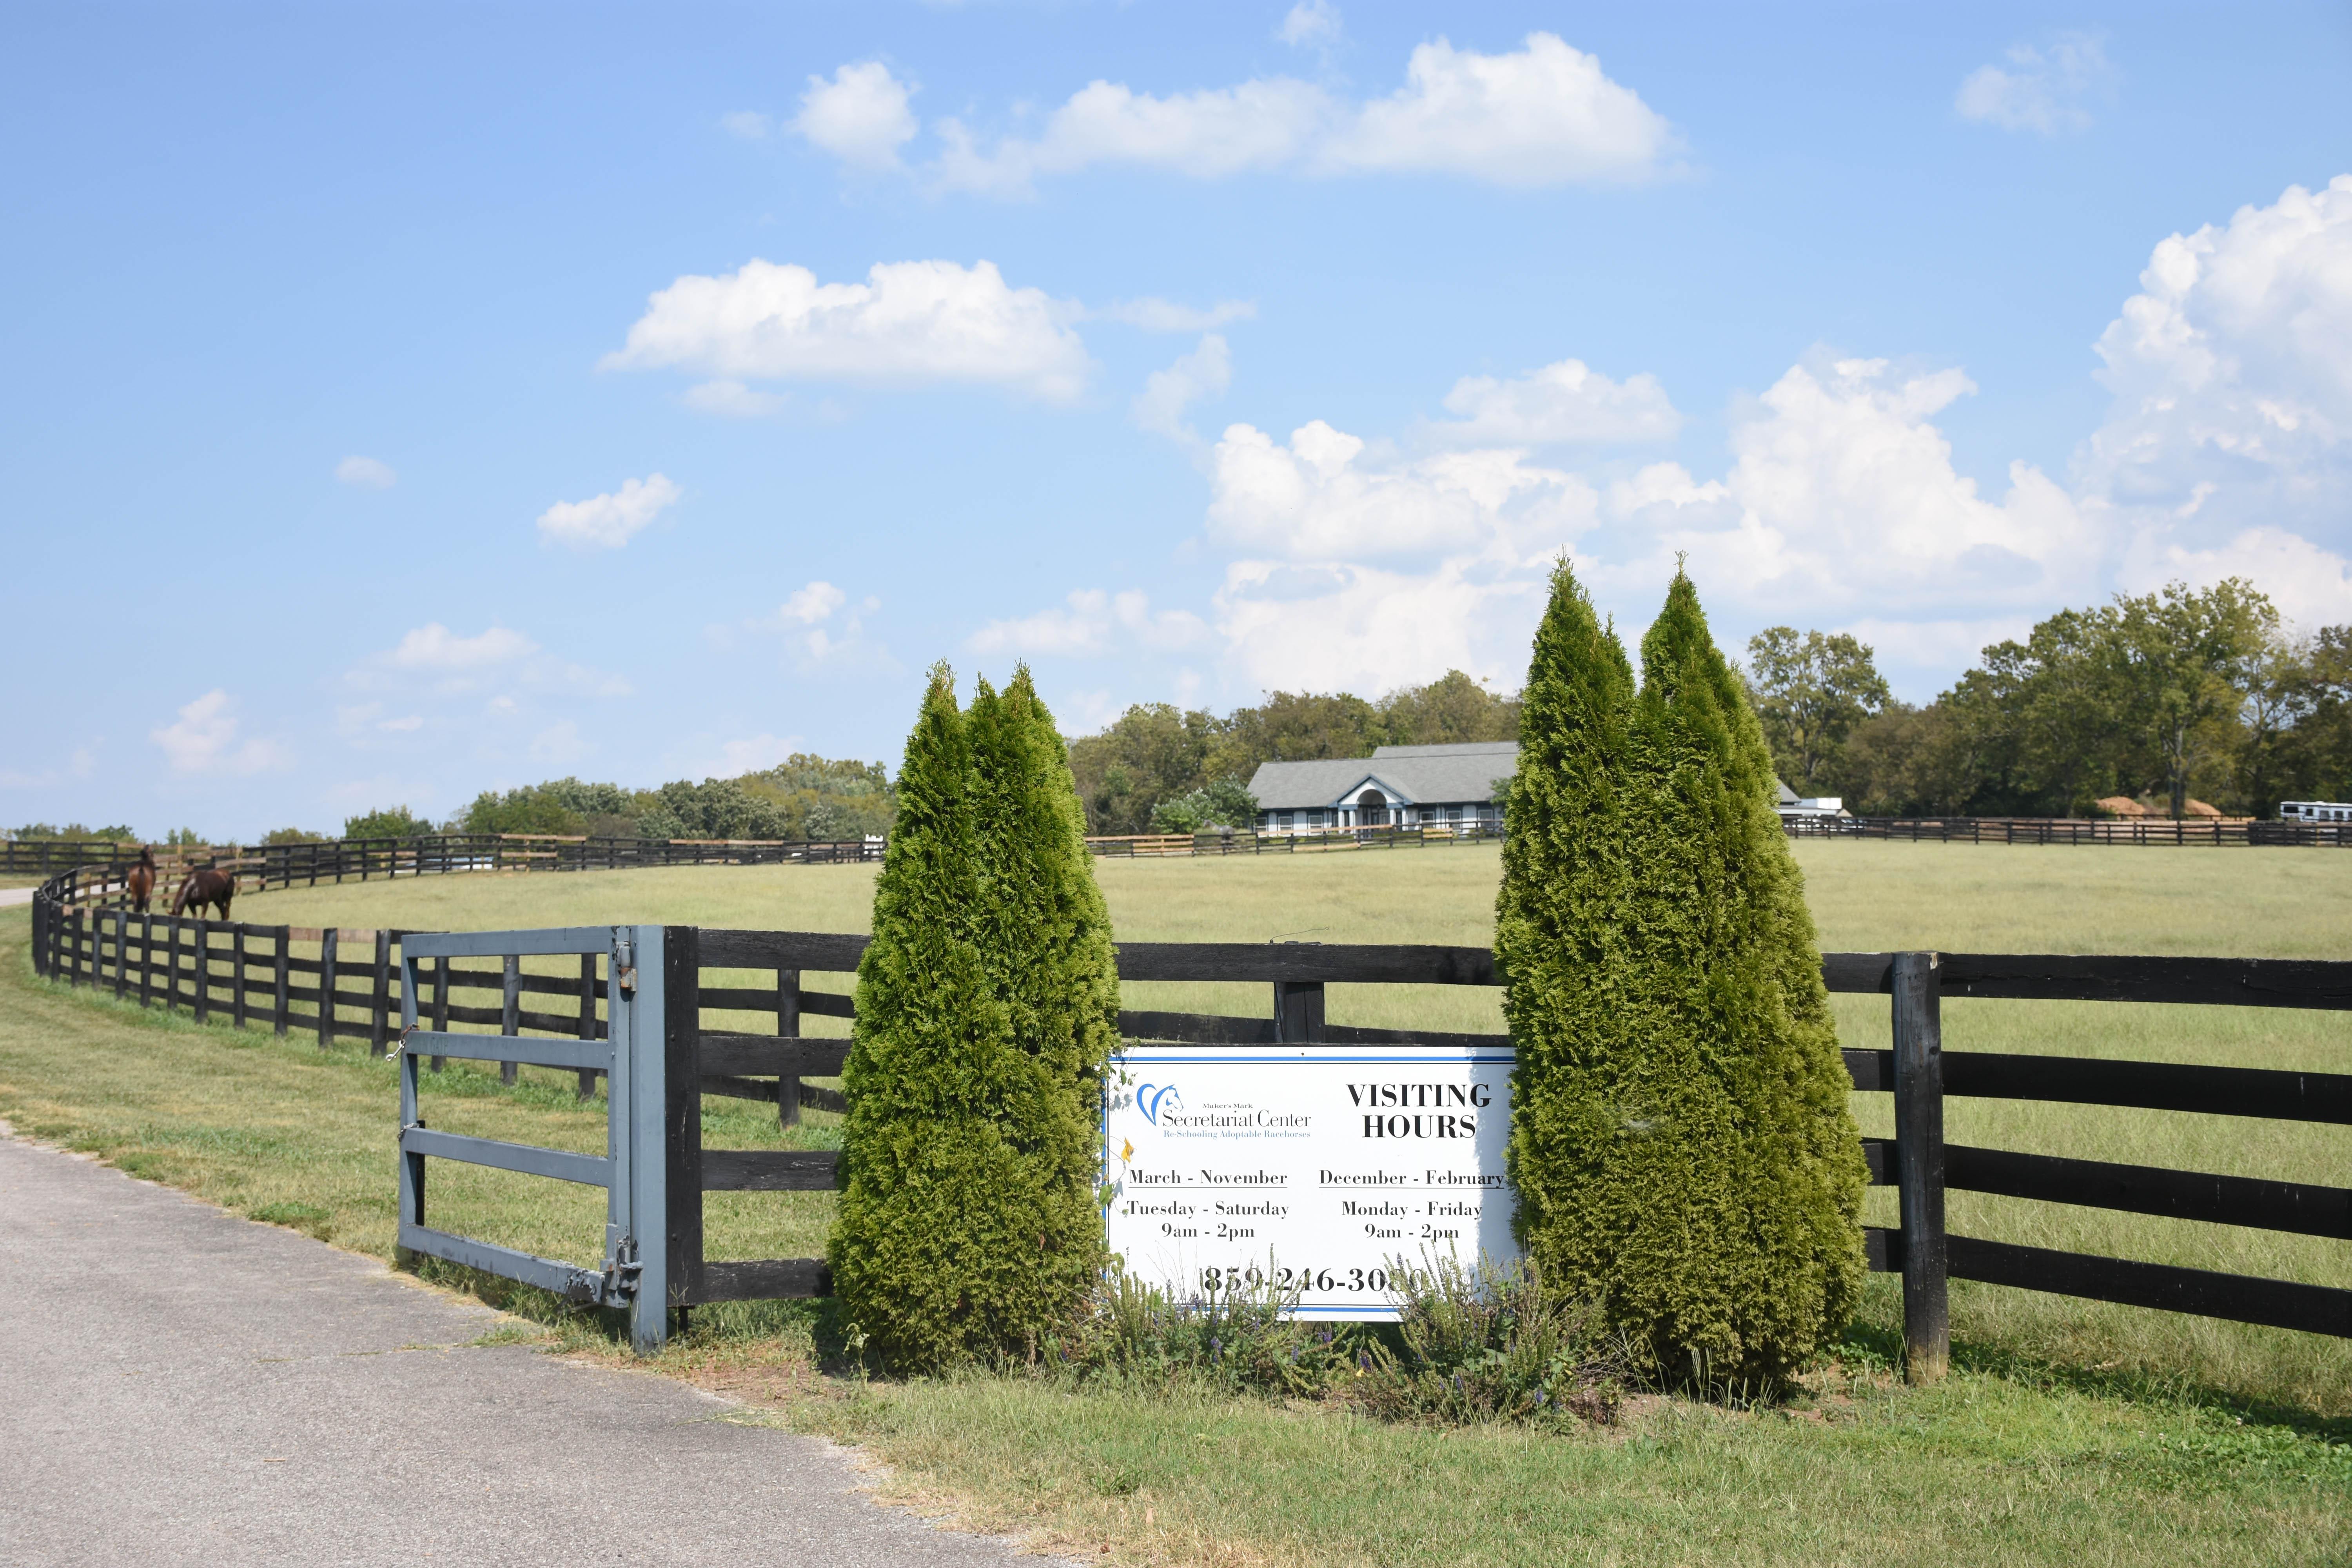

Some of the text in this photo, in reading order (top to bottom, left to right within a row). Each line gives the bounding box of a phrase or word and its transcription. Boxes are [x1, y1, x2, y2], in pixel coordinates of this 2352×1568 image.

[1346, 1083, 1492, 1108] VISITING
[1163, 1109, 1311, 1127] Secretariat Center
[1362, 1114, 1476, 1138] HOURS
[1164, 1130, 1218, 1139] Re-Schooling
[1220, 1130, 1261, 1140] Adoptable
[1129, 1169, 1181, 1183] March
[1200, 1170, 1287, 1184] November
[1319, 1170, 1406, 1184] December
[1426, 1169, 1504, 1188] February
[1126, 1201, 1196, 1219] Tuesday
[1216, 1201, 1289, 1219] Saturday
[1342, 1201, 1408, 1220] Monday
[1427, 1201, 1482, 1220] Friday
[1162, 1223, 1197, 1237] 9am
[1218, 1223, 1254, 1241] 2pm
[1365, 1223, 1401, 1238] 9am
[1421, 1224, 1459, 1241] 2pm
